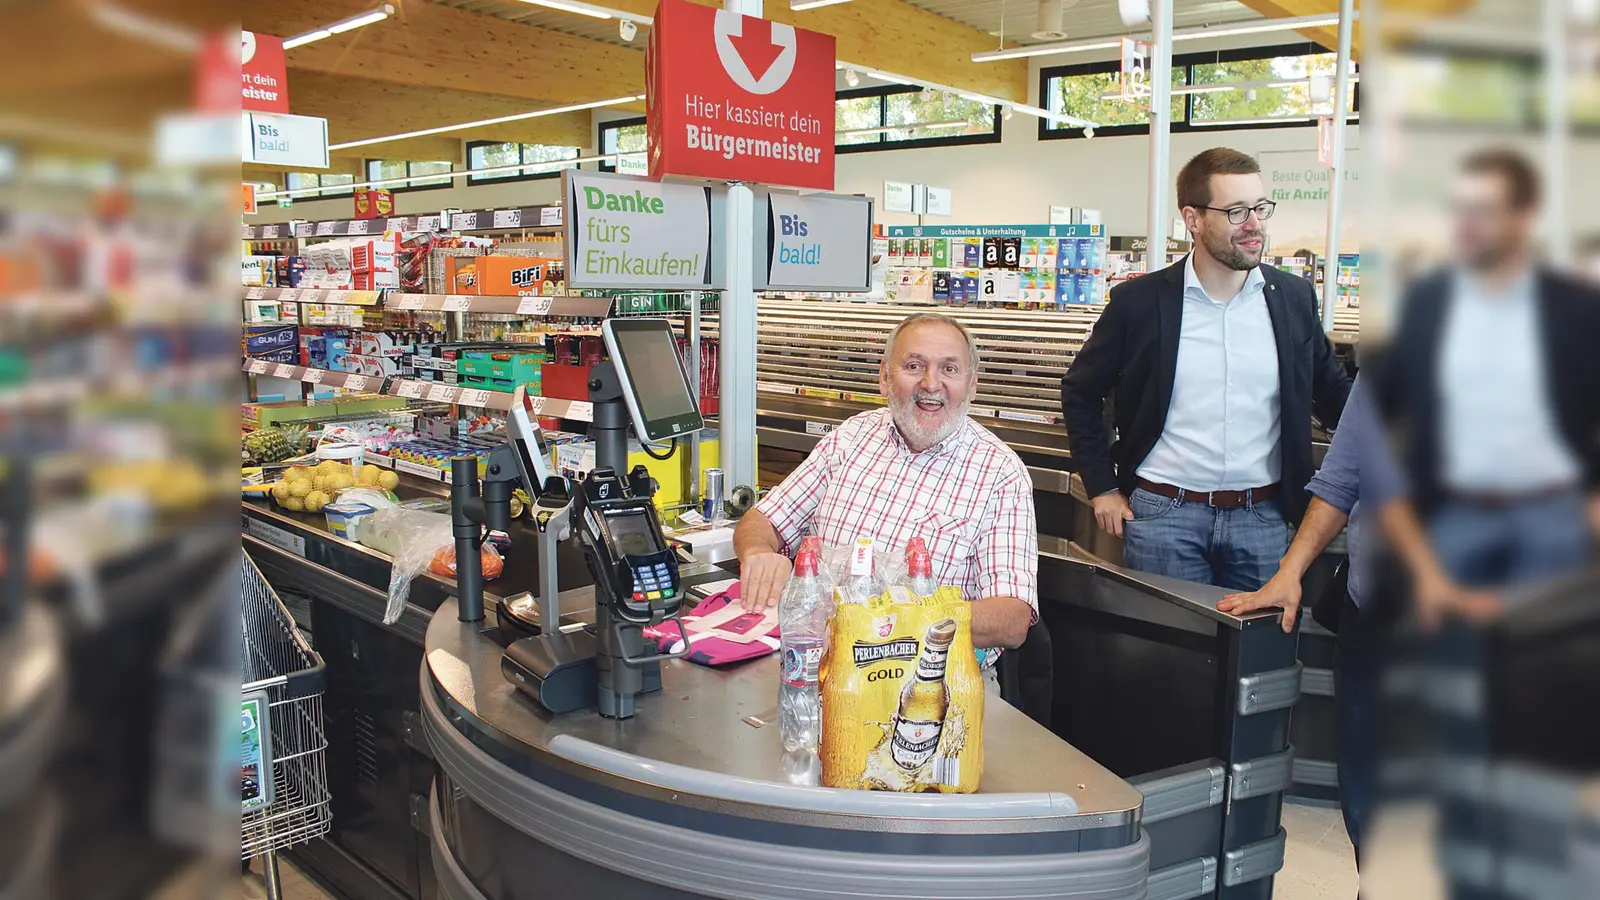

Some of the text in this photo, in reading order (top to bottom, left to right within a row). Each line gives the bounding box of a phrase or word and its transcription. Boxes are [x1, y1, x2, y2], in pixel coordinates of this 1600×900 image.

[254, 73, 277, 87] dein
[686, 93, 821, 134] Hier kassiert dein
[258, 124, 279, 137] Bis
[260, 138, 290, 152] bald!
[686, 124, 821, 164] Bürgermeister
[621, 159, 647, 170] Danke
[1272, 170, 1301, 182] Beste
[583, 185, 664, 214] Danke
[1272, 188, 1290, 201] für
[587, 217, 631, 243] fürs
[780, 215, 808, 238] Bis
[940, 228, 1027, 237] Gutscheine & Unterhaltung
[779, 242, 821, 266] bald!
[586, 249, 699, 276] Einkaufen!
[511, 266, 541, 286] BiFi
[631, 296, 652, 307] GIN
[258, 336, 277, 344] GUM
[384, 347, 405, 355] nutella
[854, 643, 917, 662] PERLENBACHER
[868, 668, 904, 682] GOLD
